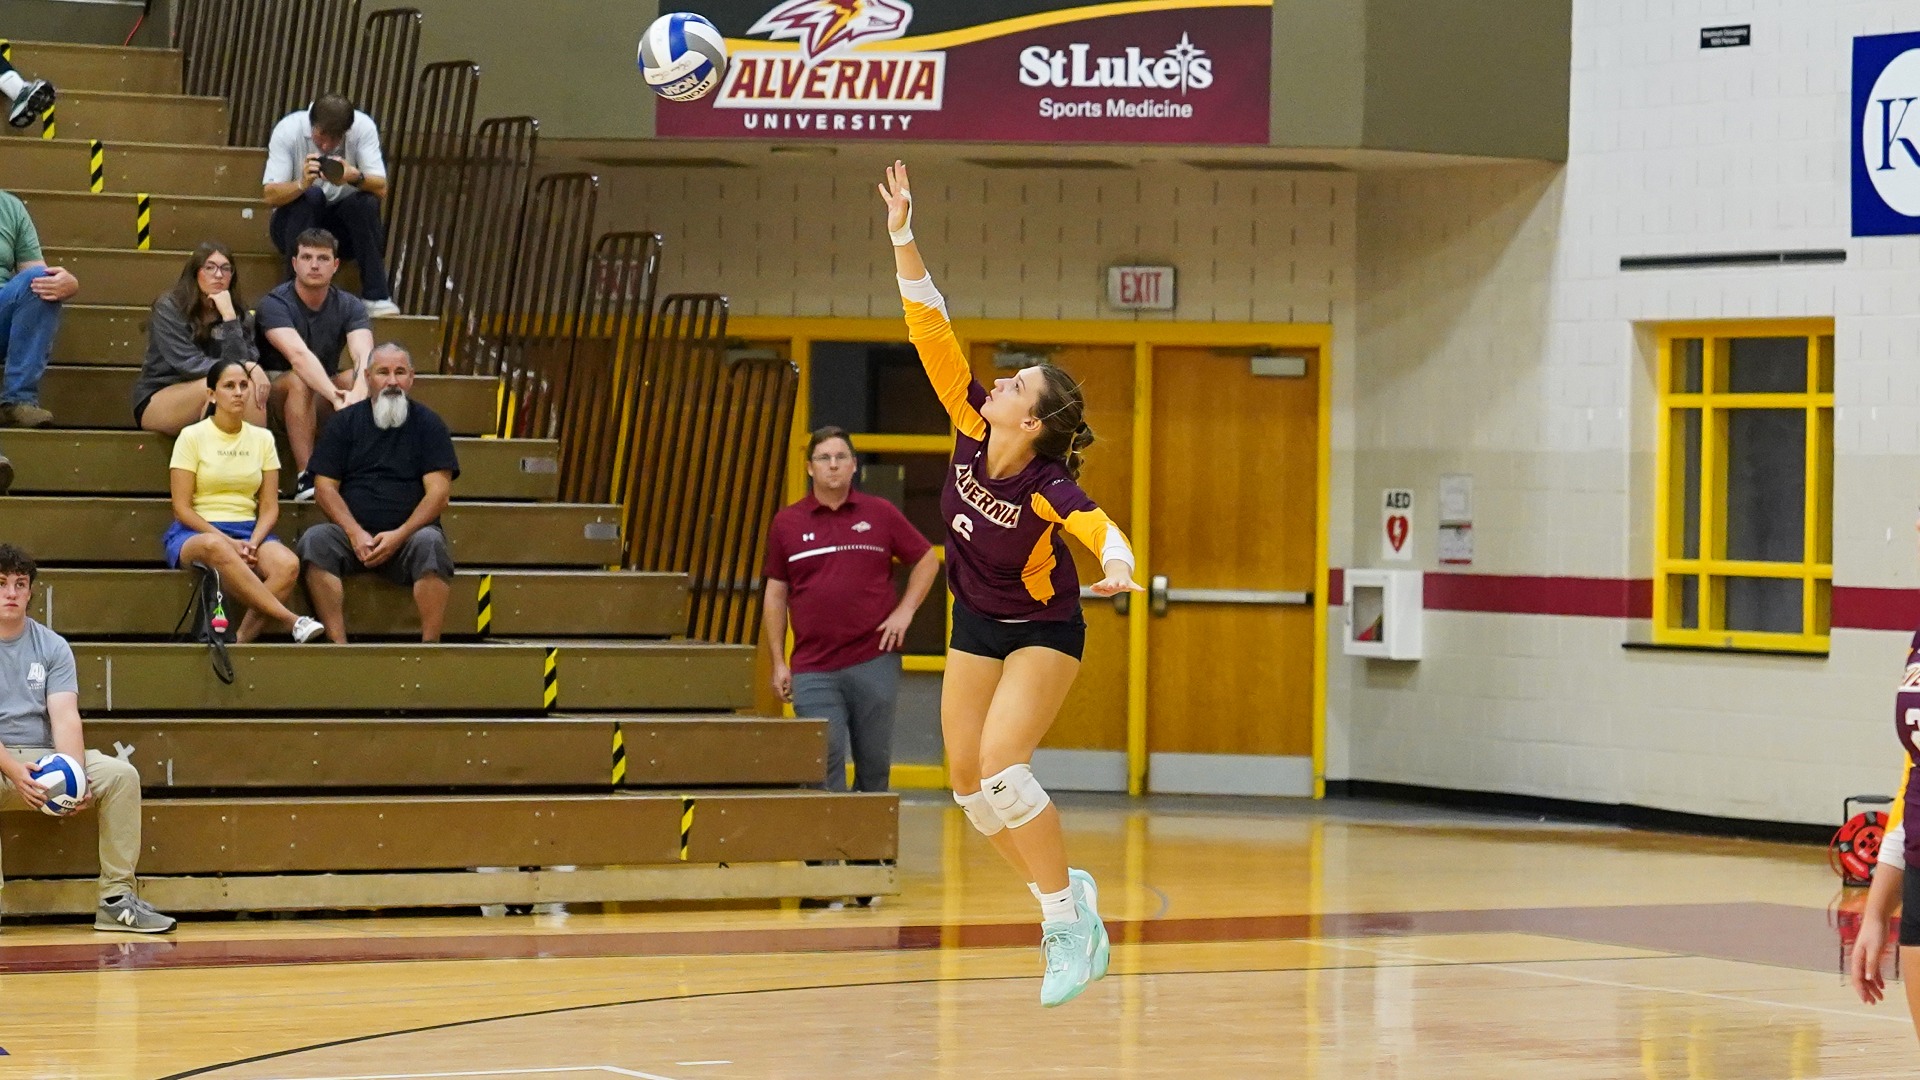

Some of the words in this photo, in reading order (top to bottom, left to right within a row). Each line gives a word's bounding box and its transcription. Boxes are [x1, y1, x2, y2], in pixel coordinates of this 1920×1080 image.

[726, 58, 937, 100] ALVERNIA
[743, 113, 912, 130] UNIVERSITY
[1039, 98, 1102, 120] Sports
[1106, 98, 1193, 118] Medicine
[1121, 272, 1162, 303] EXIT
[957, 464, 1021, 528] ALVERNIA
[1386, 492, 1411, 509] AED
